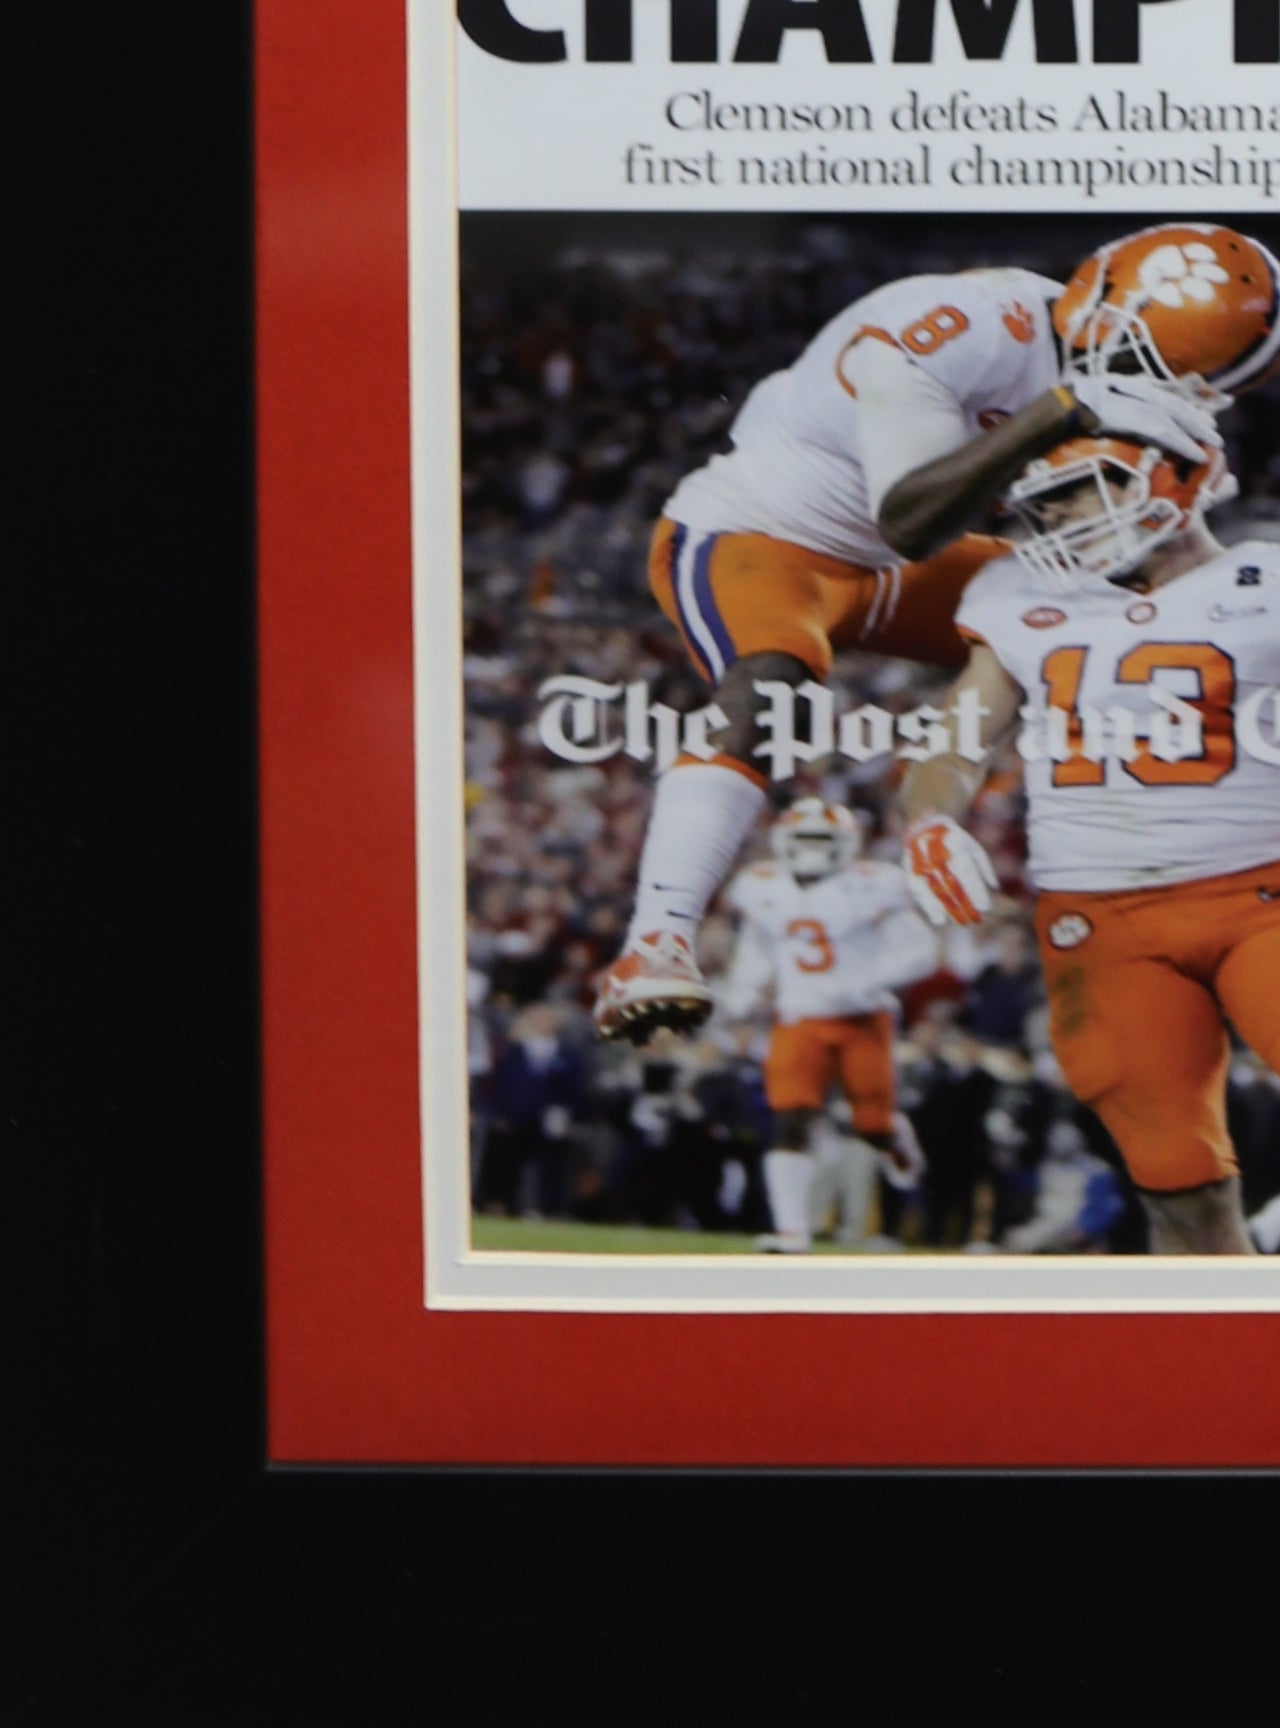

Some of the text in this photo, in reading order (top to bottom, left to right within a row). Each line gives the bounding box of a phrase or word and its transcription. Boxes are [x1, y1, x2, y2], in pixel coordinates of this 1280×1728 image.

[664, 91, 871, 132] Clemson
[890, 91, 1058, 132] defeats
[623, 144, 722, 185] first
[738, 144, 932, 186] national
[902, 305, 969, 355] 8
[536, 674, 731, 768] The
[751, 680, 991, 780] Post
[1040, 640, 1237, 787] 13
[786, 917, 836, 975] 3
